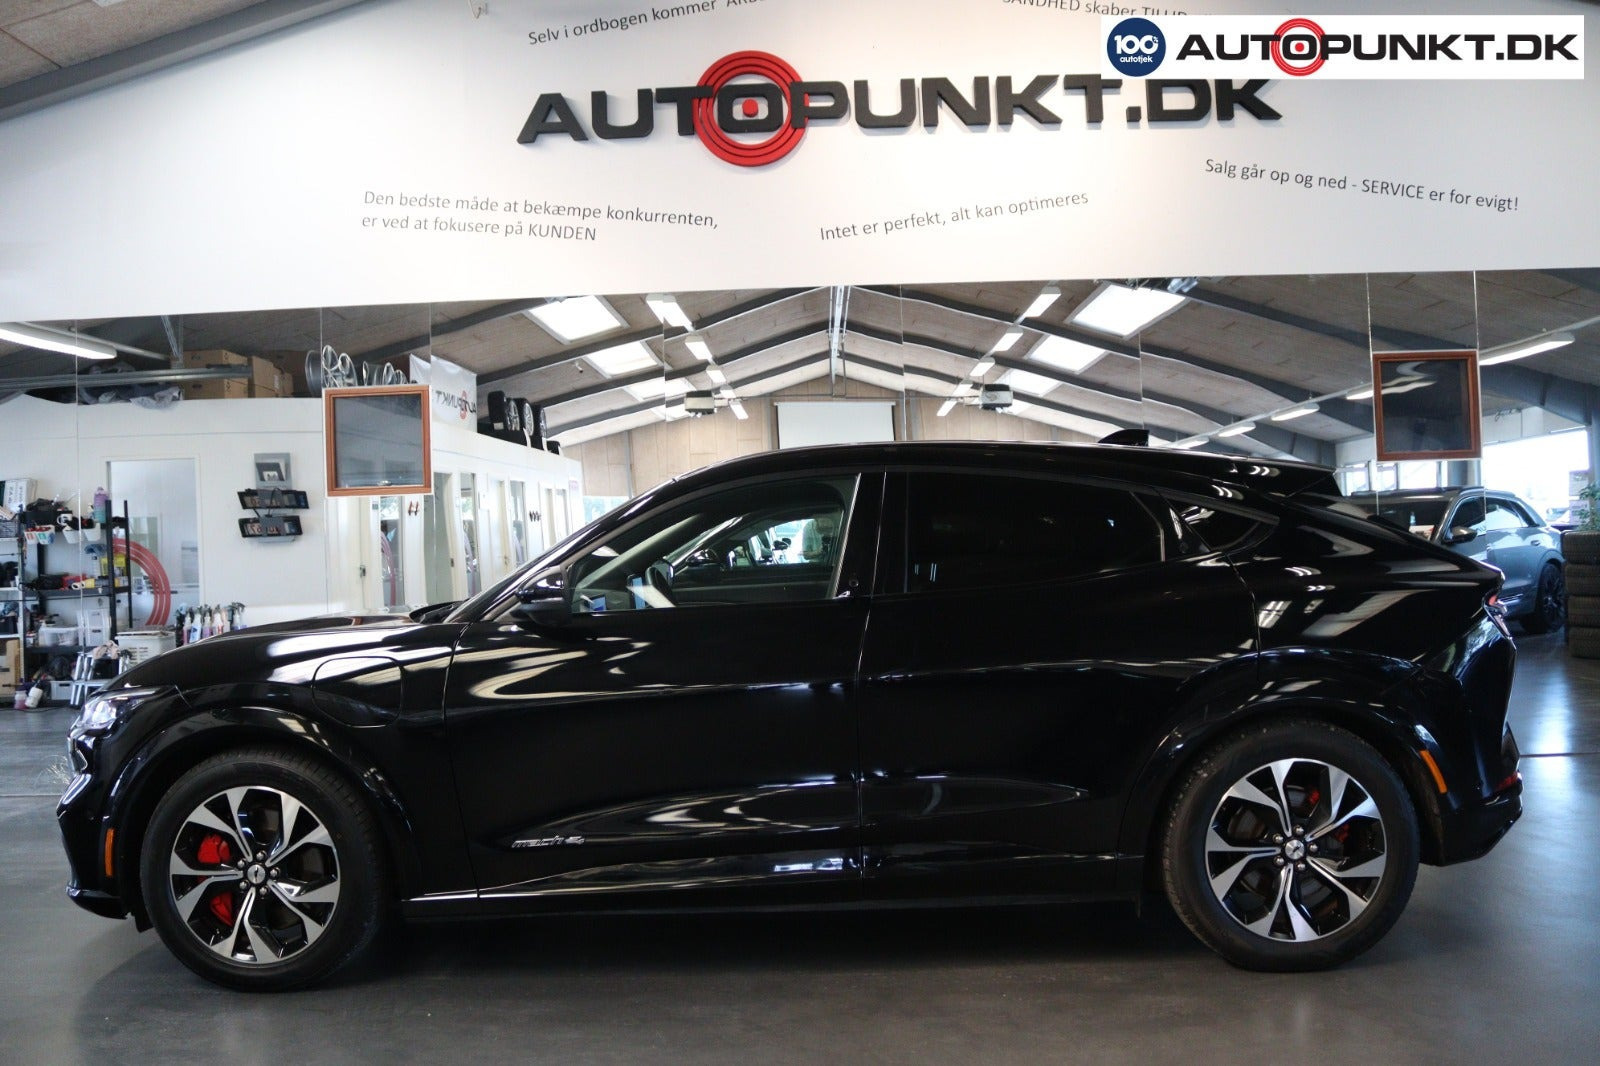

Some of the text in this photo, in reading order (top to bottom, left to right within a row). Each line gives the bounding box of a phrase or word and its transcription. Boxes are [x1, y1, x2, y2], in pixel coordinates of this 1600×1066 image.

[528, 29, 560, 45] Selv
[564, 25, 569, 38] i
[573, 13, 648, 36] ordbogen
[652, 0, 717, 21] kommer
[1003, 0, 1080, 11] DHED
[1085, 1, 1136, 16] skaber
[516, 74, 1282, 145] AUTOPUNKT.DK
[1205, 158, 1237, 179] Salg
[1241, 164, 1266, 181] går
[1270, 169, 1290, 184] op
[1294, 173, 1313, 188] og
[1318, 175, 1347, 190] ned
[1361, 178, 1425, 199] SERVICE
[1429, 188, 1445, 201] er
[1450, 189, 1472, 205] for
[1475, 196, 1519, 212] evigt!
[361, 214, 597, 241] er ved at fokusere på KUNDEN
[364, 190, 719, 229] Den bedste måde at bekæmpe konkurrenten,
[820, 192, 1089, 241] Intet er perfekt, alt kan optimeres
